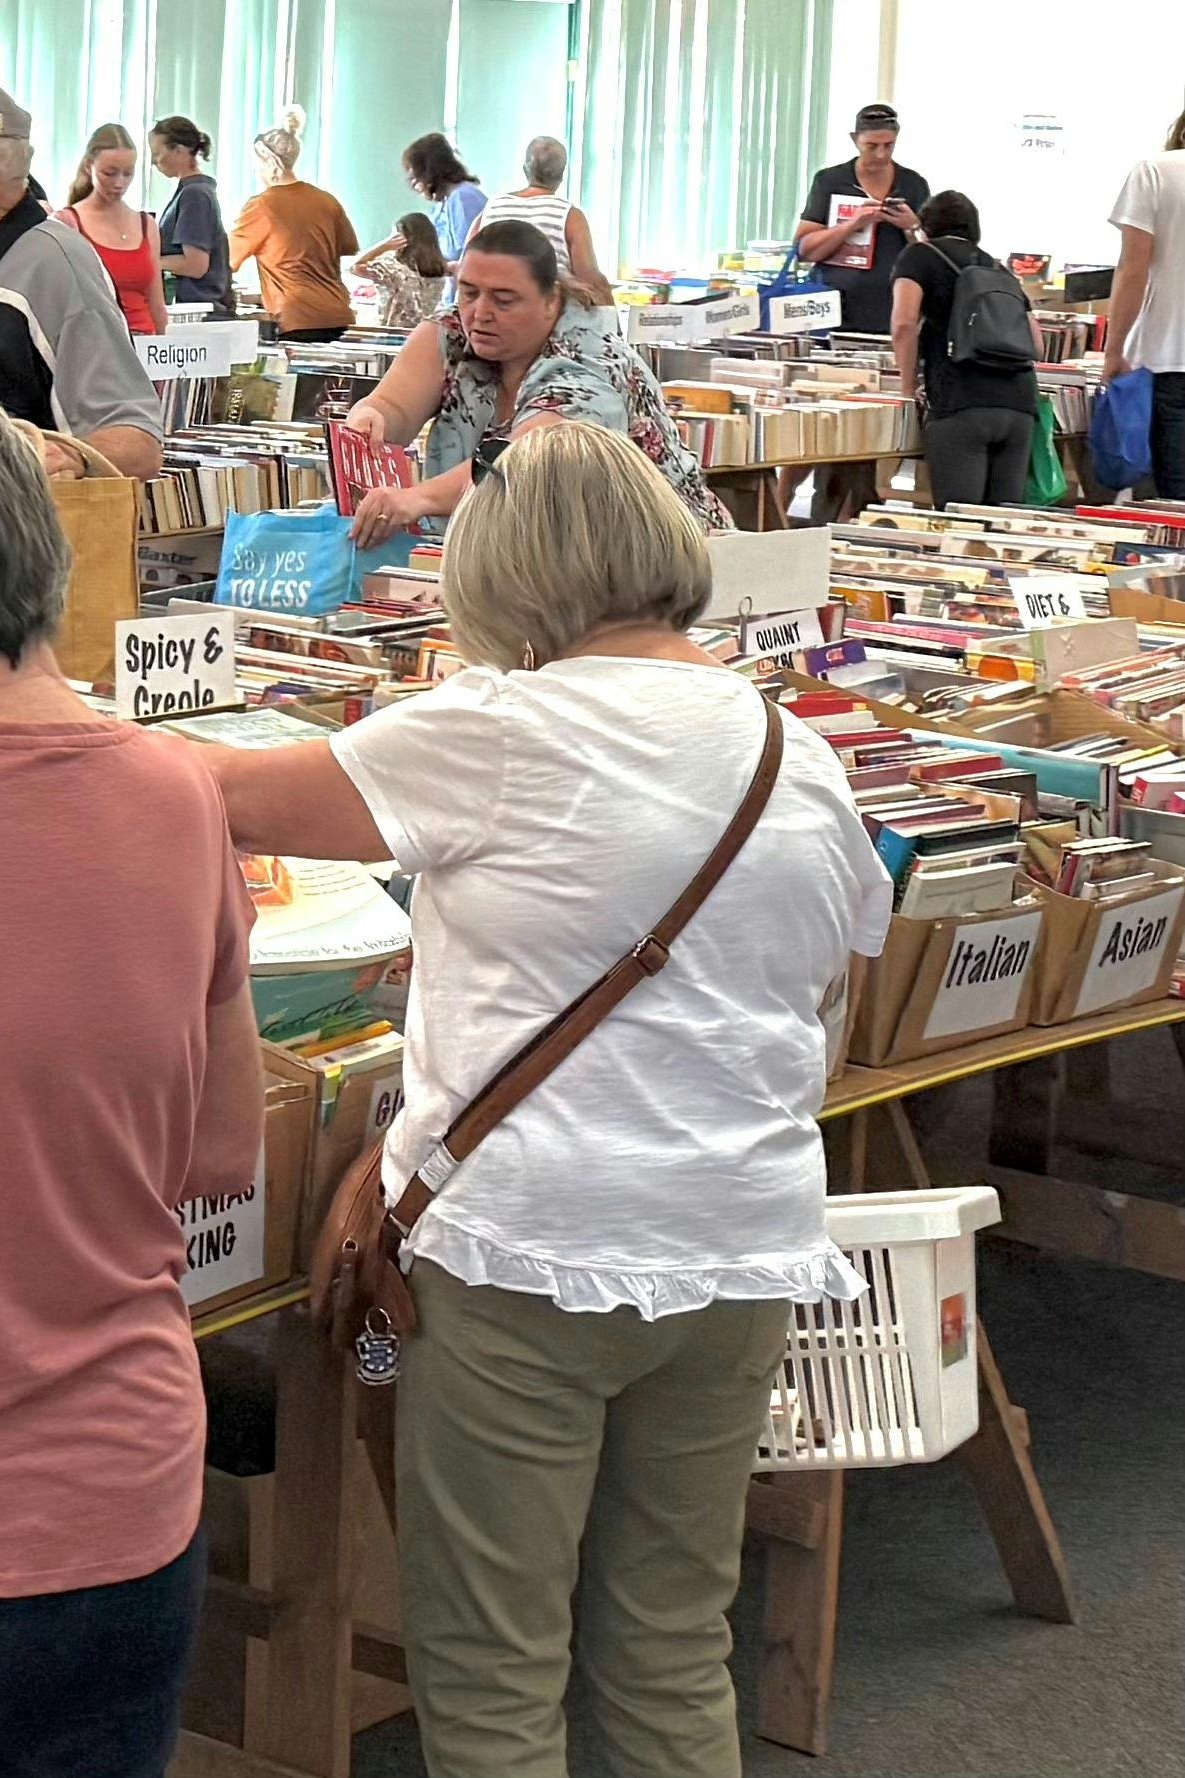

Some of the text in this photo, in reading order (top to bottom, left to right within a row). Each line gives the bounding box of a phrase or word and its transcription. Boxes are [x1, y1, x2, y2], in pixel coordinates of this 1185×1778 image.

[147, 344, 207, 367] Religion
[232, 543, 307, 578] Say yes
[230, 578, 311, 608] TO LESS
[1025, 593, 1056, 619] DIET
[126, 626, 223, 681] Spicy &
[755, 621, 801, 652] QUAINT
[1098, 916, 1167, 968] Asian
[945, 934, 1030, 988] Italian
[186, 1221, 236, 1270] KING
